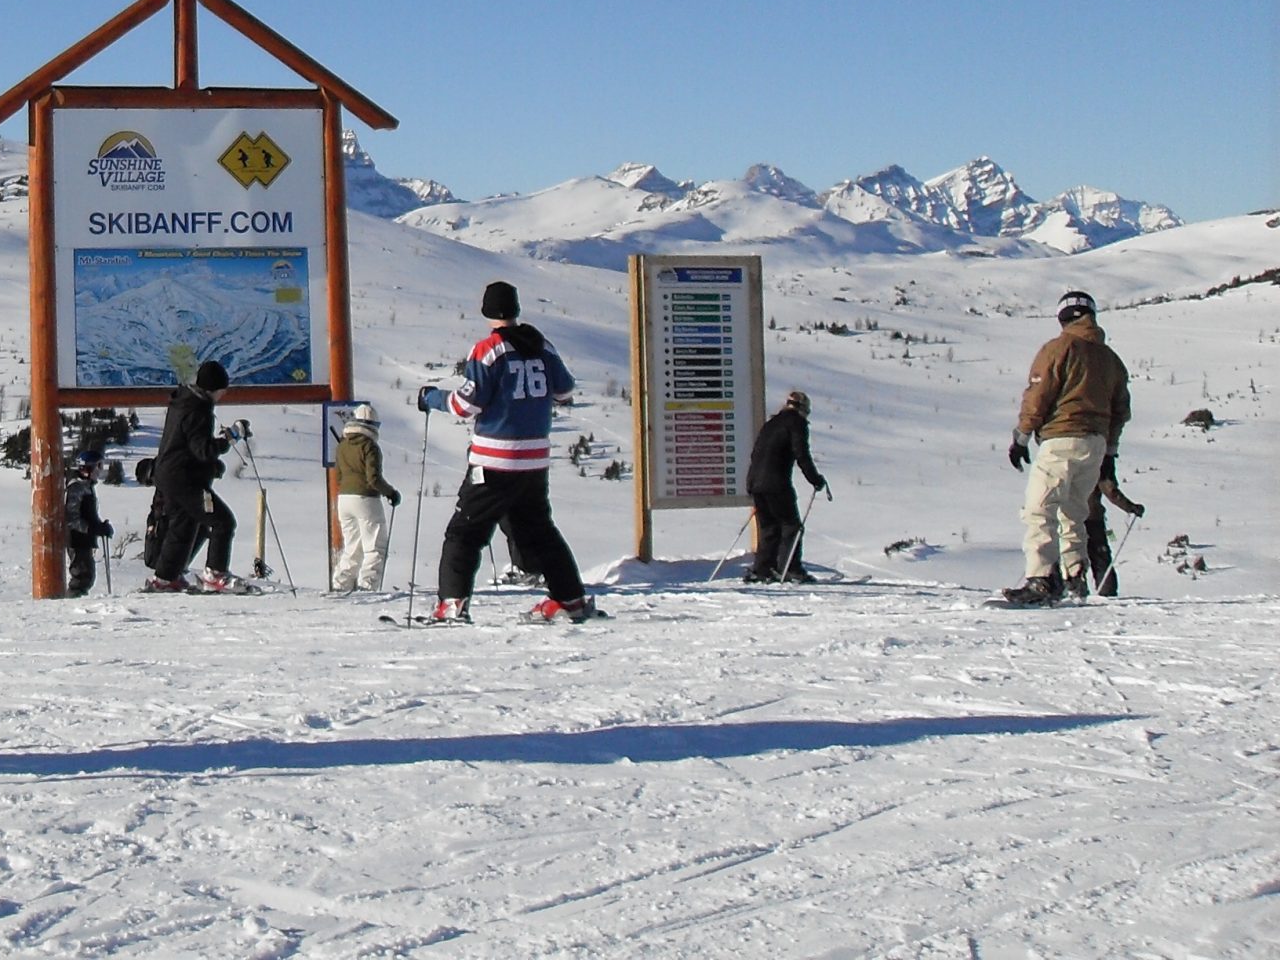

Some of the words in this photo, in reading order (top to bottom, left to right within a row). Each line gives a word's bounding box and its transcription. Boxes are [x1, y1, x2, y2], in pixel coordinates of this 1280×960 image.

[87, 158, 163, 175] SUNSHINE
[99, 171, 166, 187] VILLAGE
[88, 211, 294, 235] SKIBANFF.COM
[508, 359, 548, 400] 76
